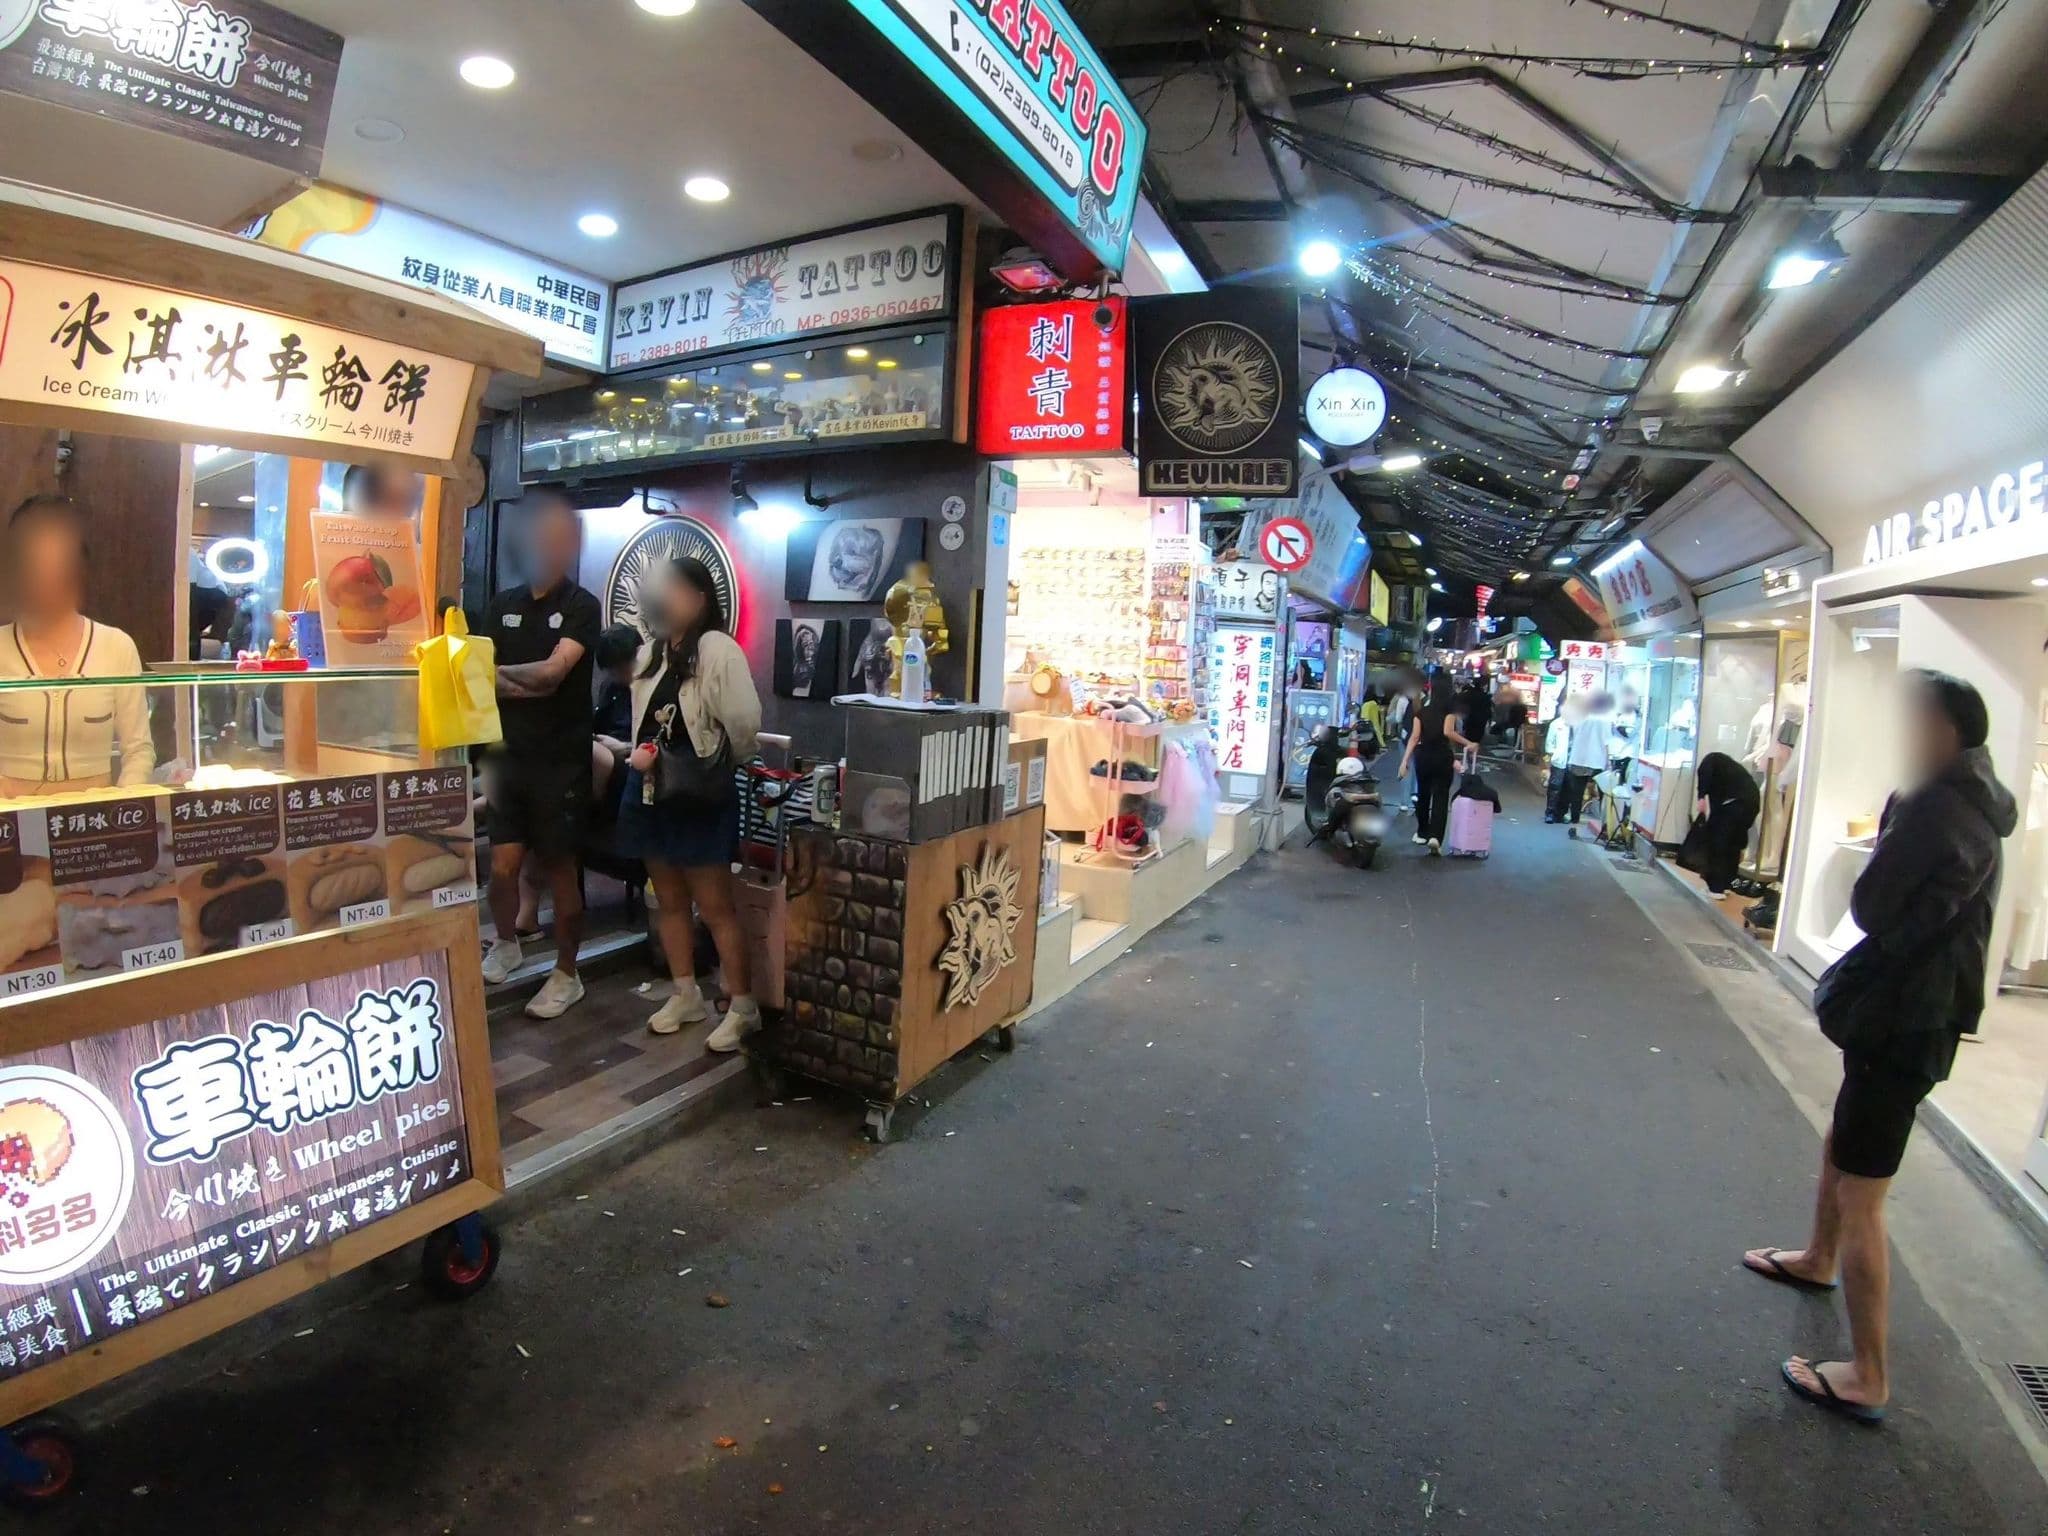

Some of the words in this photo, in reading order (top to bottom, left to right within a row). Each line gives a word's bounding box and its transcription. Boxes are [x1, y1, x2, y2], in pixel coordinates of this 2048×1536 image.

[31, 57, 92, 89] 台灣美食
[104, 60, 123, 74] The
[128, 66, 171, 89] Ultimate
[175, 83, 210, 101] Classic
[214, 95, 264, 119] Taiwanese
[267, 113, 303, 132] Cuisine
[253, 74, 284, 93] Wheel
[287, 86, 309, 102] pies
[971, 0, 1125, 196] ATTOO
[537, 274, 601, 312] 中華民國
[616, 287, 713, 338] KEVIN
[799, 239, 945, 298] TATTOO
[830, 295, 942, 326] 0936-050467
[51, 292, 431, 425] 冰淇淋車輪餅
[640, 335, 708, 361] 2389-8018
[1026, 313, 1073, 418] 刺青
[42, 375, 72, 394] Ice
[79, 380, 138, 404] Cream
[1317, 397, 1342, 410] Xin
[1351, 397, 1376, 410] Xin
[1010, 424, 1084, 440] TATTOO
[1862, 512, 1911, 565] AIR
[1920, 461, 2044, 546] SPACE
[351, 783, 372, 799] ice
[387, 775, 439, 800] 香草冰
[443, 775, 462, 789] ice
[175, 798, 242, 820] 巧克力冰
[248, 794, 271, 811] ice
[287, 787, 346, 810] 花生冰
[49, 812, 108, 837] 芋頭冰
[117, 807, 143, 825] ice
[347, 905, 384, 922] NT:40
[131, 947, 176, 966] NT:40
[7, 970, 56, 993] NT:30
[137, 980, 442, 1161] 車輪餅
[293, 1120, 383, 1170] Wheel
[396, 1098, 451, 1138] pies
[161, 1156, 288, 1221] 今川焼き
[100, 1268, 138, 1292] The
[145, 1235, 228, 1274] Ultimate
[236, 1206, 301, 1239] Classic
[307, 1167, 394, 1210] Taiwanese
[401, 1140, 458, 1170] Cuisine
[0, 1296, 57, 1336] 經典
